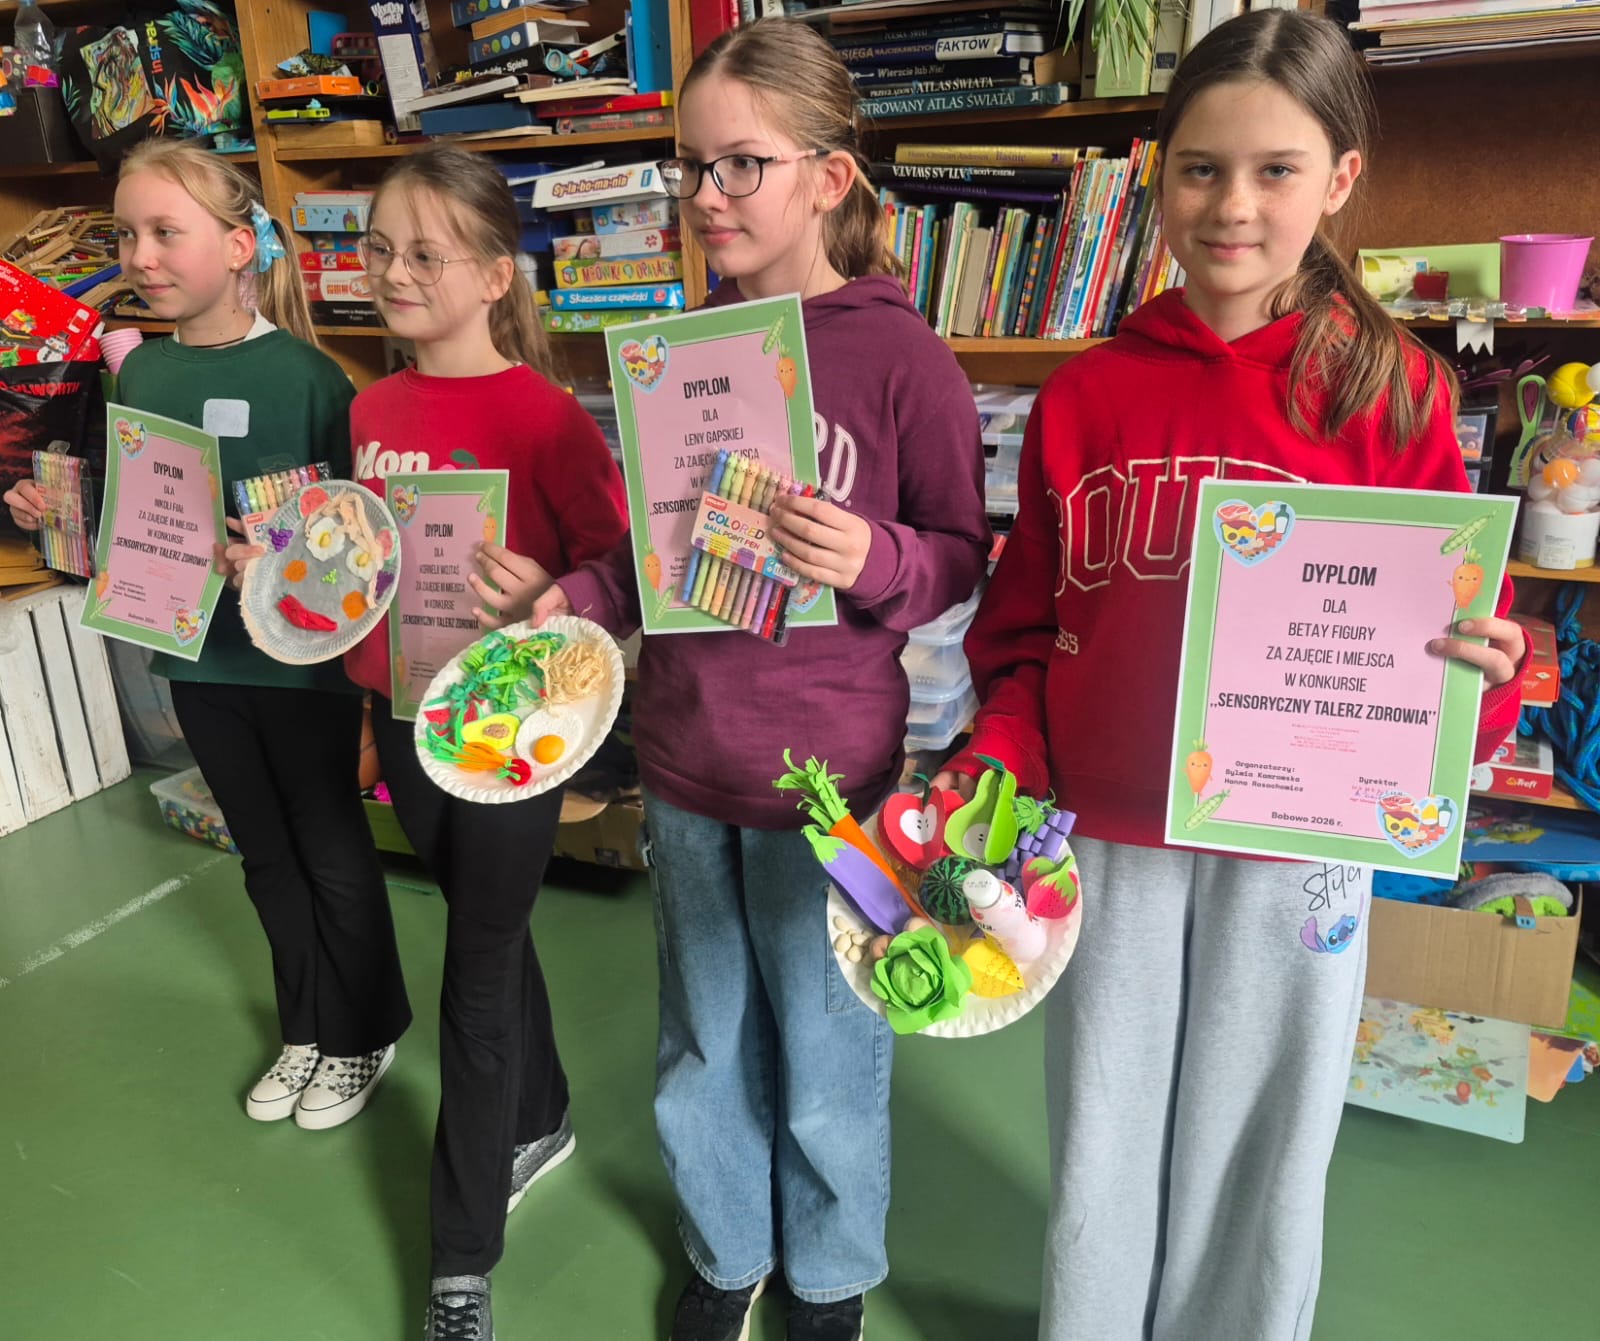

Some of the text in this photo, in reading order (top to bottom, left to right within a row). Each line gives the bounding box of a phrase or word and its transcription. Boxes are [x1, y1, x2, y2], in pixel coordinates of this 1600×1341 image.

[916, 80, 950, 94] ATLAS
[950, 76, 993, 92] ŚWIATA
[860, 94, 1013, 116] STROWANY ATLAS ŚWIATA
[340, 255, 362, 265] Puzz
[684, 376, 730, 399] DYPLOM
[702, 408, 719, 423] DLA
[684, 427, 744, 447] LENY GAPSKIEJ
[674, 457, 686, 470] ZA
[687, 453, 716, 468] ZAJĘCI
[153, 461, 184, 480] DYPLOM
[163, 485, 175, 496] DLA
[690, 477, 699, 488] W
[138, 510, 147, 520] ZA
[147, 511, 168, 527] ZAJĘCIE
[175, 519, 199, 533] MIEJSCA
[425, 523, 453, 537] DYPLOM
[707, 511, 765, 540] COLORED
[147, 528, 185, 545] W KONKURSIE
[703, 523, 722, 535] BALL
[744, 539, 760, 550] PEN
[159, 547, 182, 561] TALERZ
[434, 547, 444, 557] DLA
[1302, 562, 1377, 587] DYPLOM
[1322, 598, 1347, 614] DLA
[436, 616, 455, 629] TALERZ
[1288, 622, 1376, 641] BETAY FIGURY
[1266, 646, 1395, 668] ZA ZAJĘCIE I MIEJSCA
[1284, 672, 1367, 692] W KONKURSIE
[1314, 700, 1362, 720] TALERZ
[1359, 776, 1399, 787] Dyrektor
[1516, 777, 1538, 790] Trefl
[1271, 811, 1309, 823] Bobowo
[1311, 816, 1335, 826] 2026
